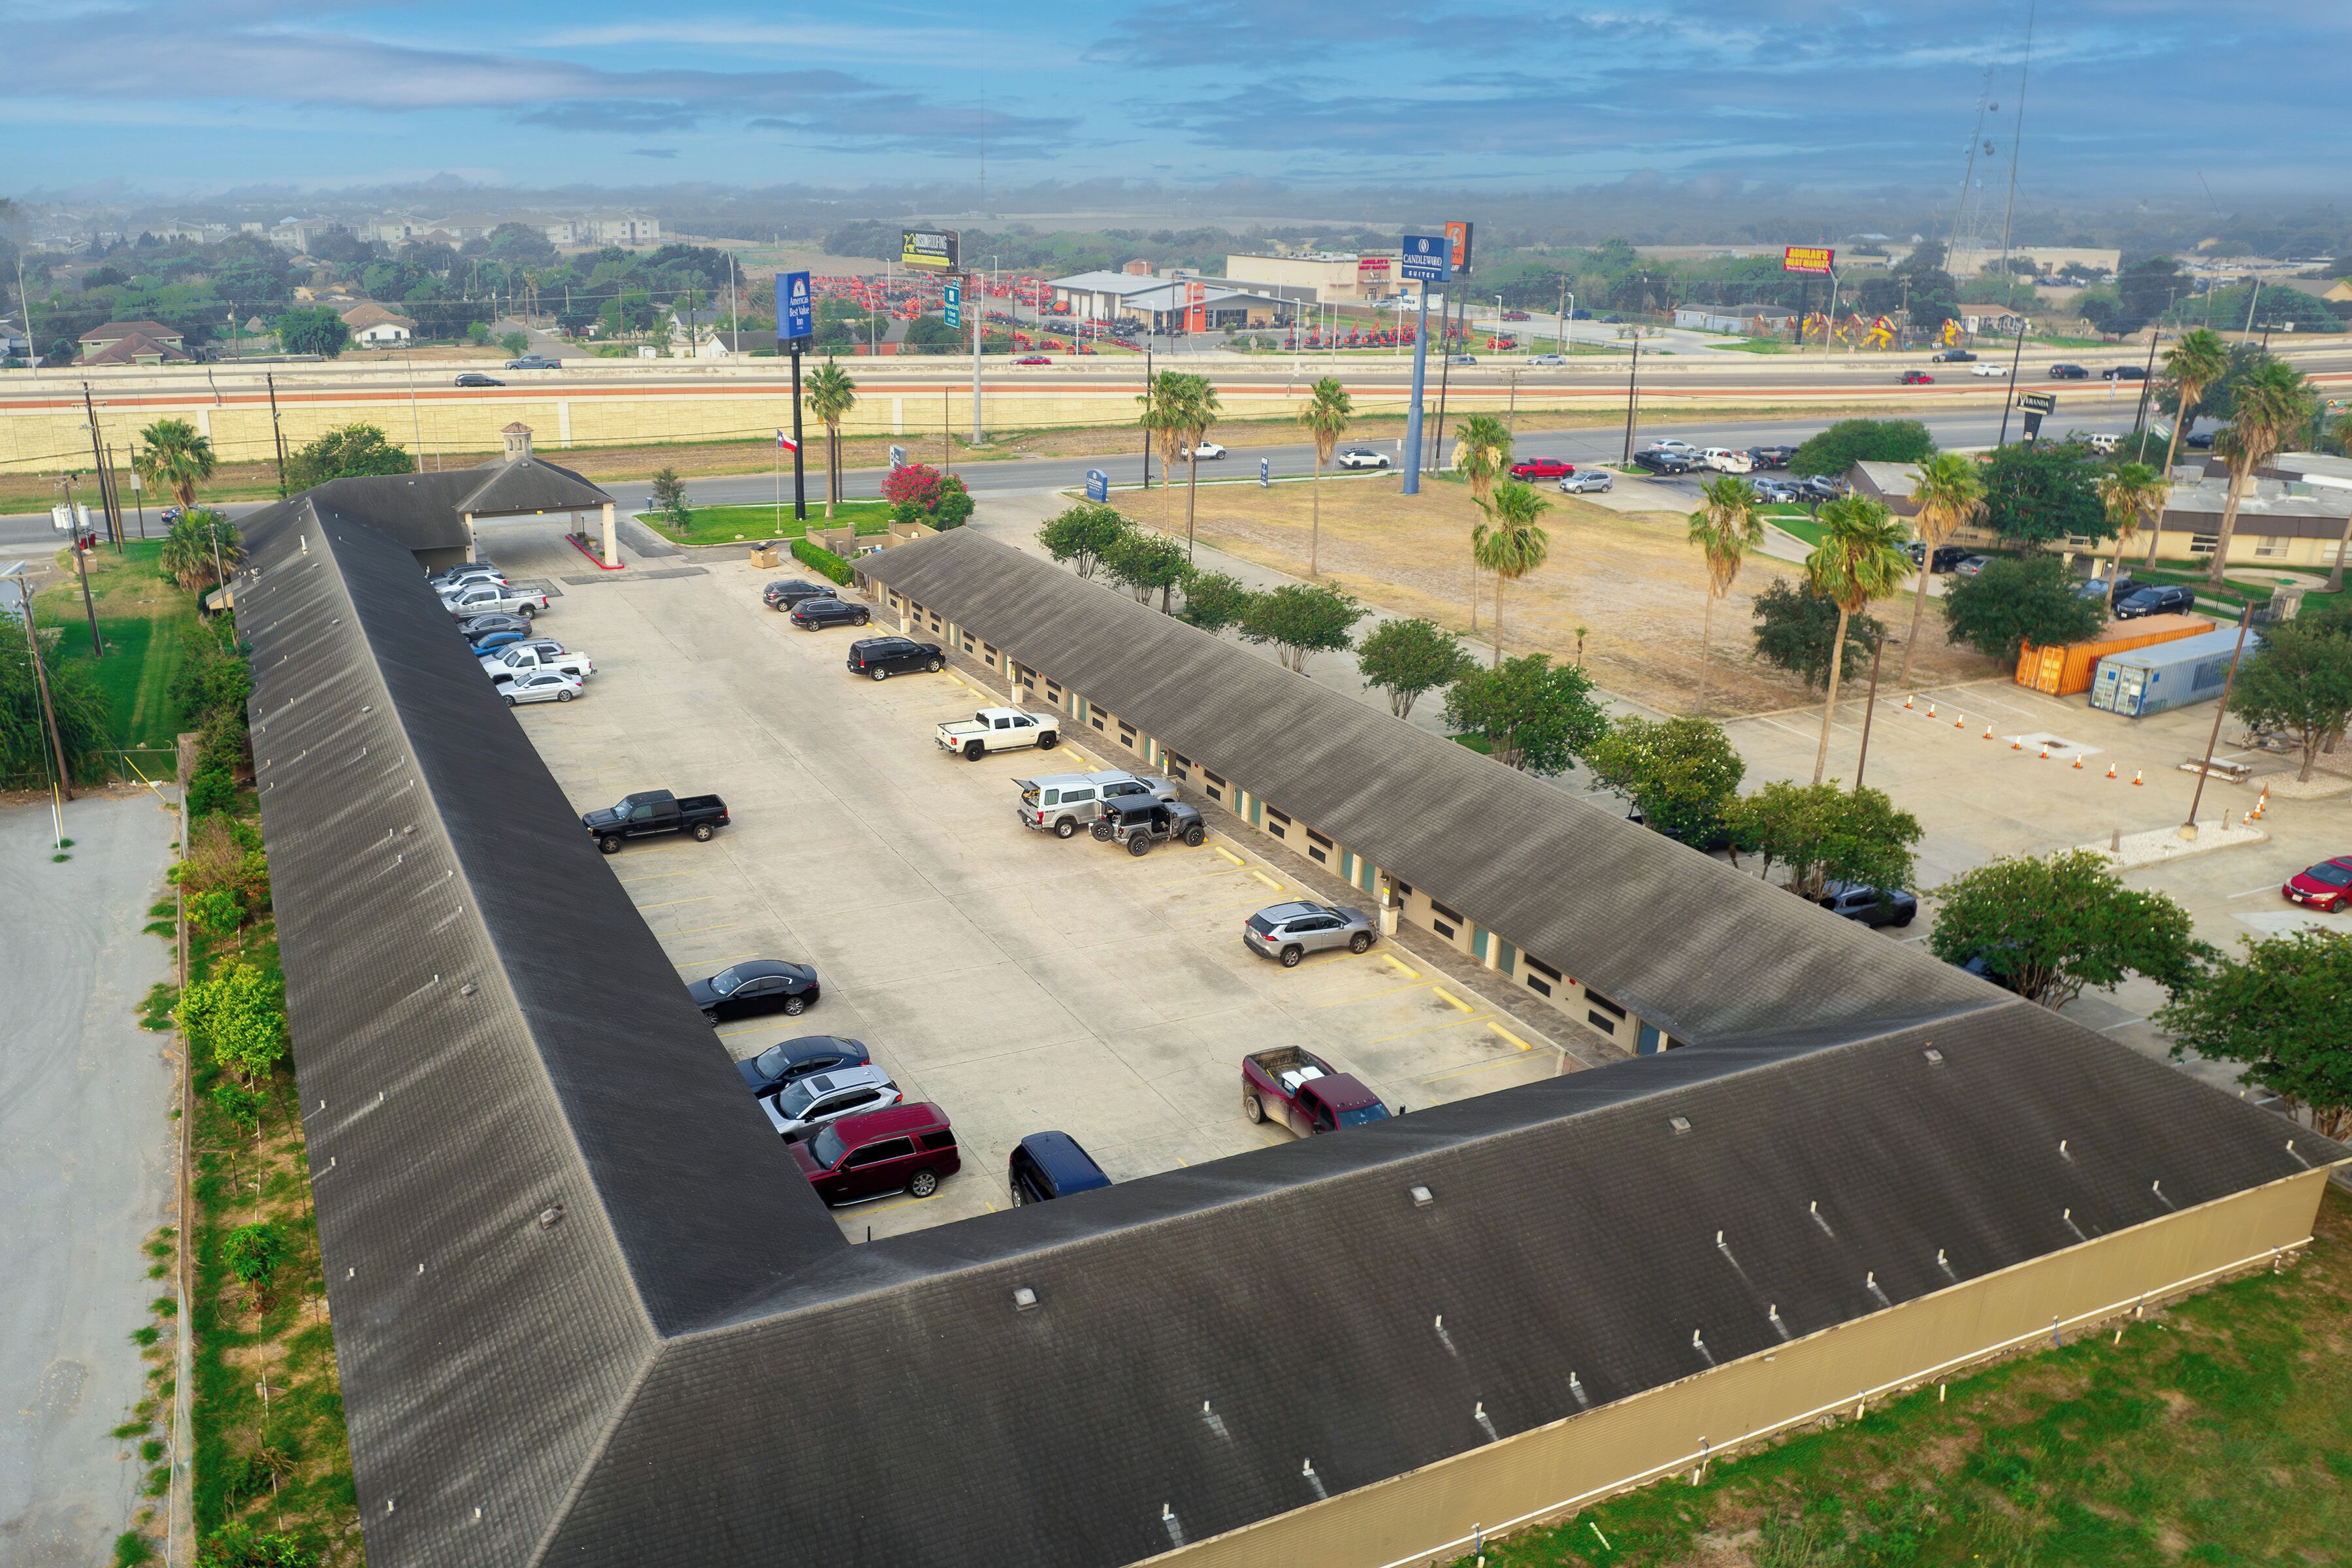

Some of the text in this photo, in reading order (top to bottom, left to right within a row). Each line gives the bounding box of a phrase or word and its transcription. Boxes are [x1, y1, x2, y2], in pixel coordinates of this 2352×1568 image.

[1403, 253, 1443, 266] CANDLEWOOD
[1409, 270, 1435, 279] SUITES
[789, 304, 810, 317] Best Value
